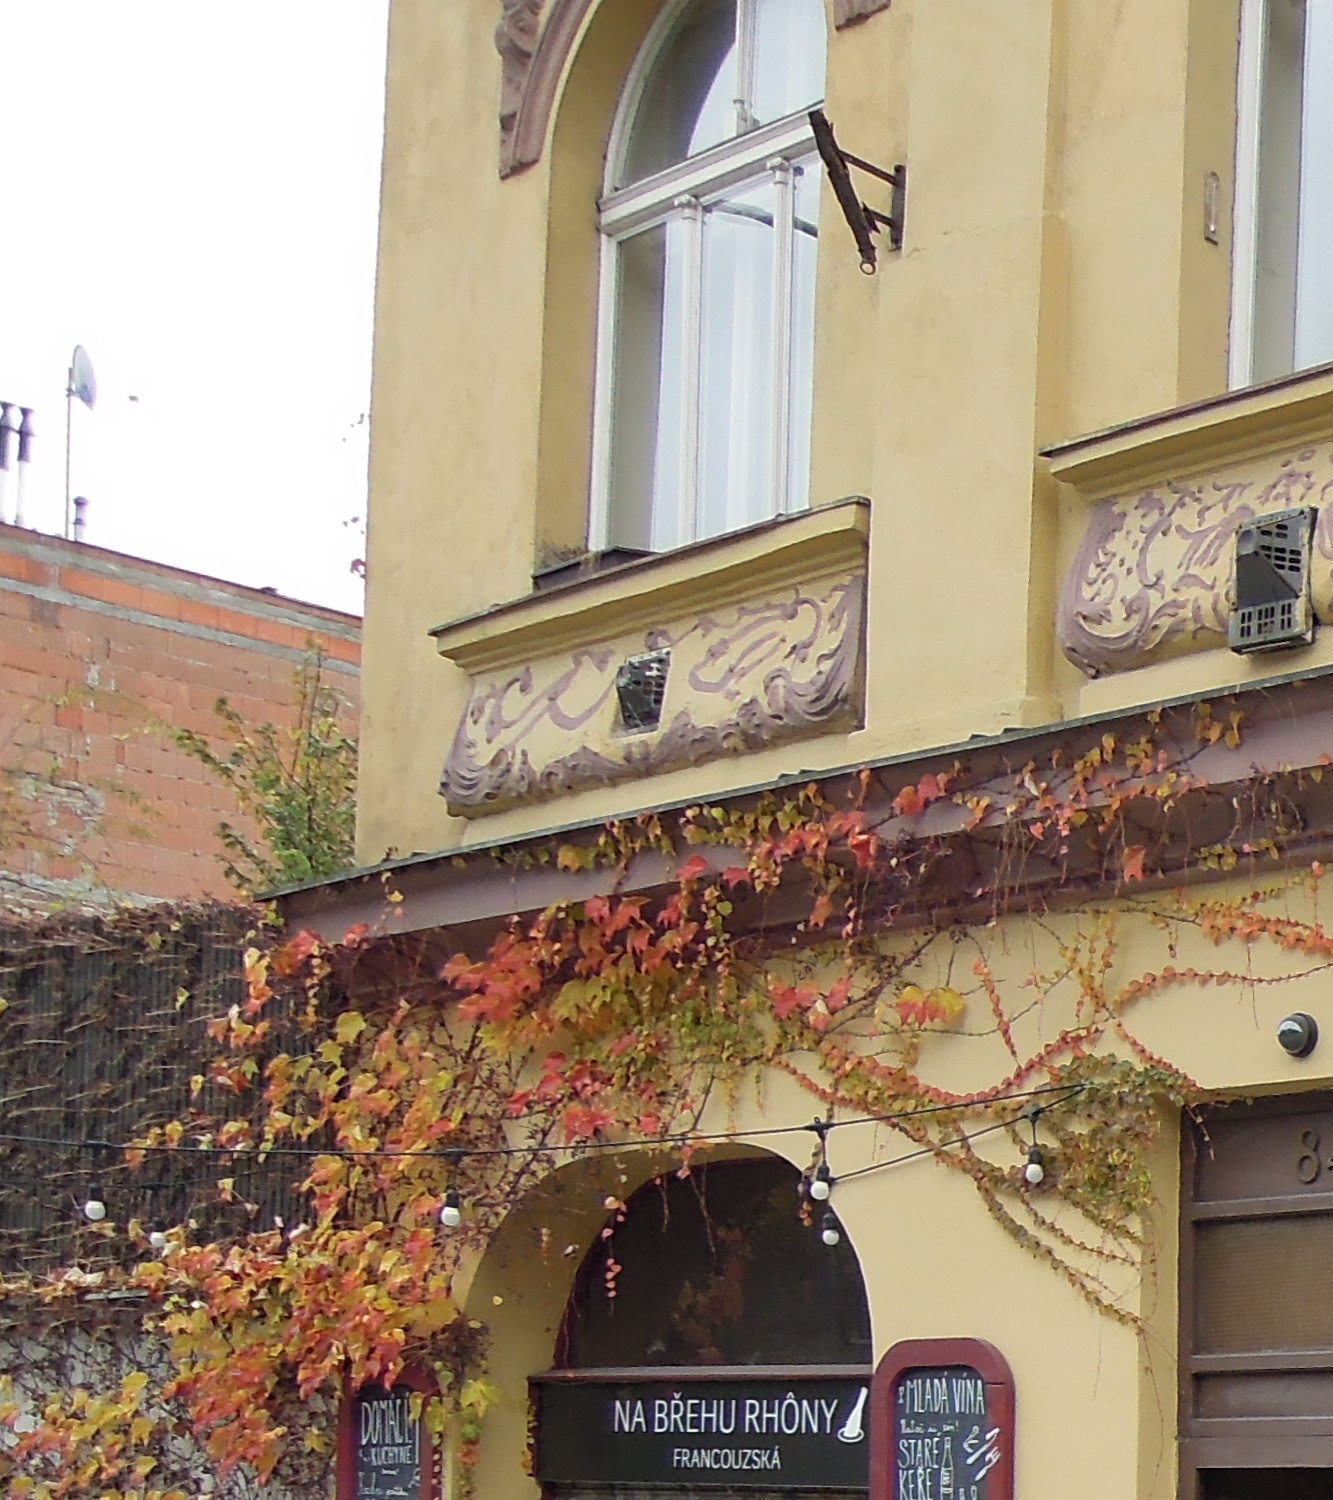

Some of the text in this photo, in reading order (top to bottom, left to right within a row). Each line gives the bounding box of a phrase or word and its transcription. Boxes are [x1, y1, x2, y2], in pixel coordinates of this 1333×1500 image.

[614, 1392, 838, 1434] NA BŘEHU RHÔNY
[673, 1446, 782, 1470] FRANCOUZSKÁ
